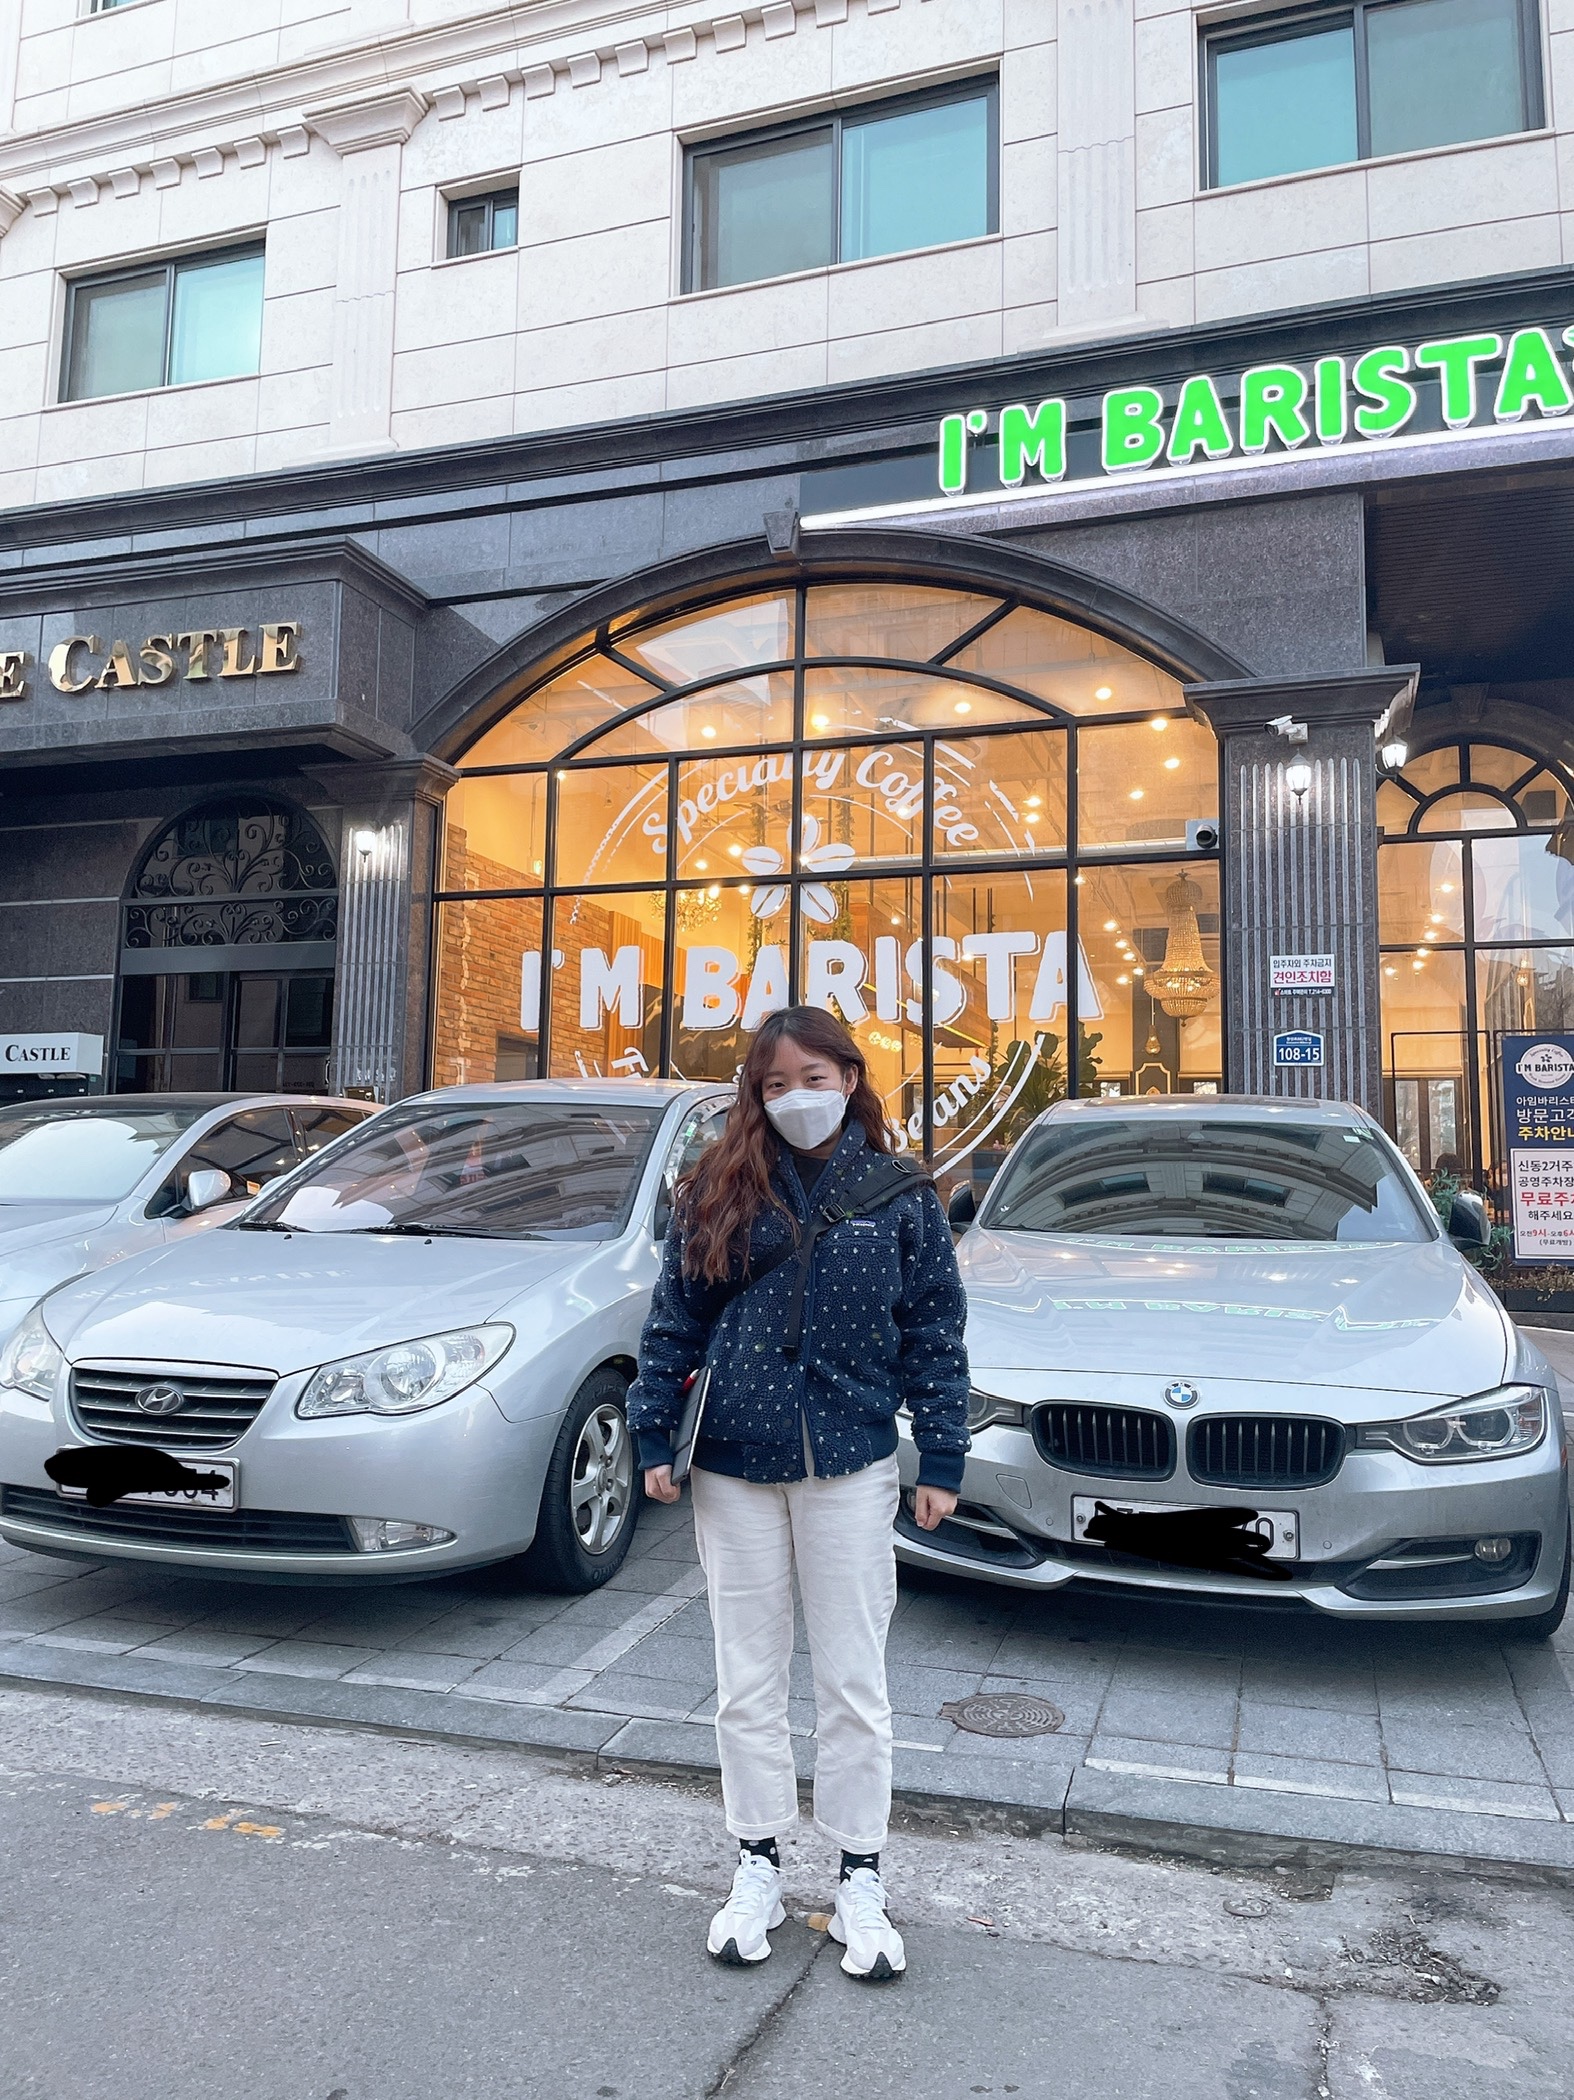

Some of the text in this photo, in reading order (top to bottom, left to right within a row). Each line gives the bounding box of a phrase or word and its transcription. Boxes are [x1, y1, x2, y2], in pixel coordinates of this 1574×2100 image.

[939, 328, 1574, 495] I'M BARISTA
[855, 751, 979, 847] Coffee
[1303, 958, 1332, 968] 주차금지
[520, 931, 1105, 1032] I'M BARISTA
[1273, 970, 1332, 984] 견인조치함
[1278, 1047, 1320, 1061] 108-15
[1517, 1063, 1574, 1073] I'M BARISTA
[1520, 1192, 1574, 1207] 무료주
[1528, 1210, 1574, 1221] 해주세요
